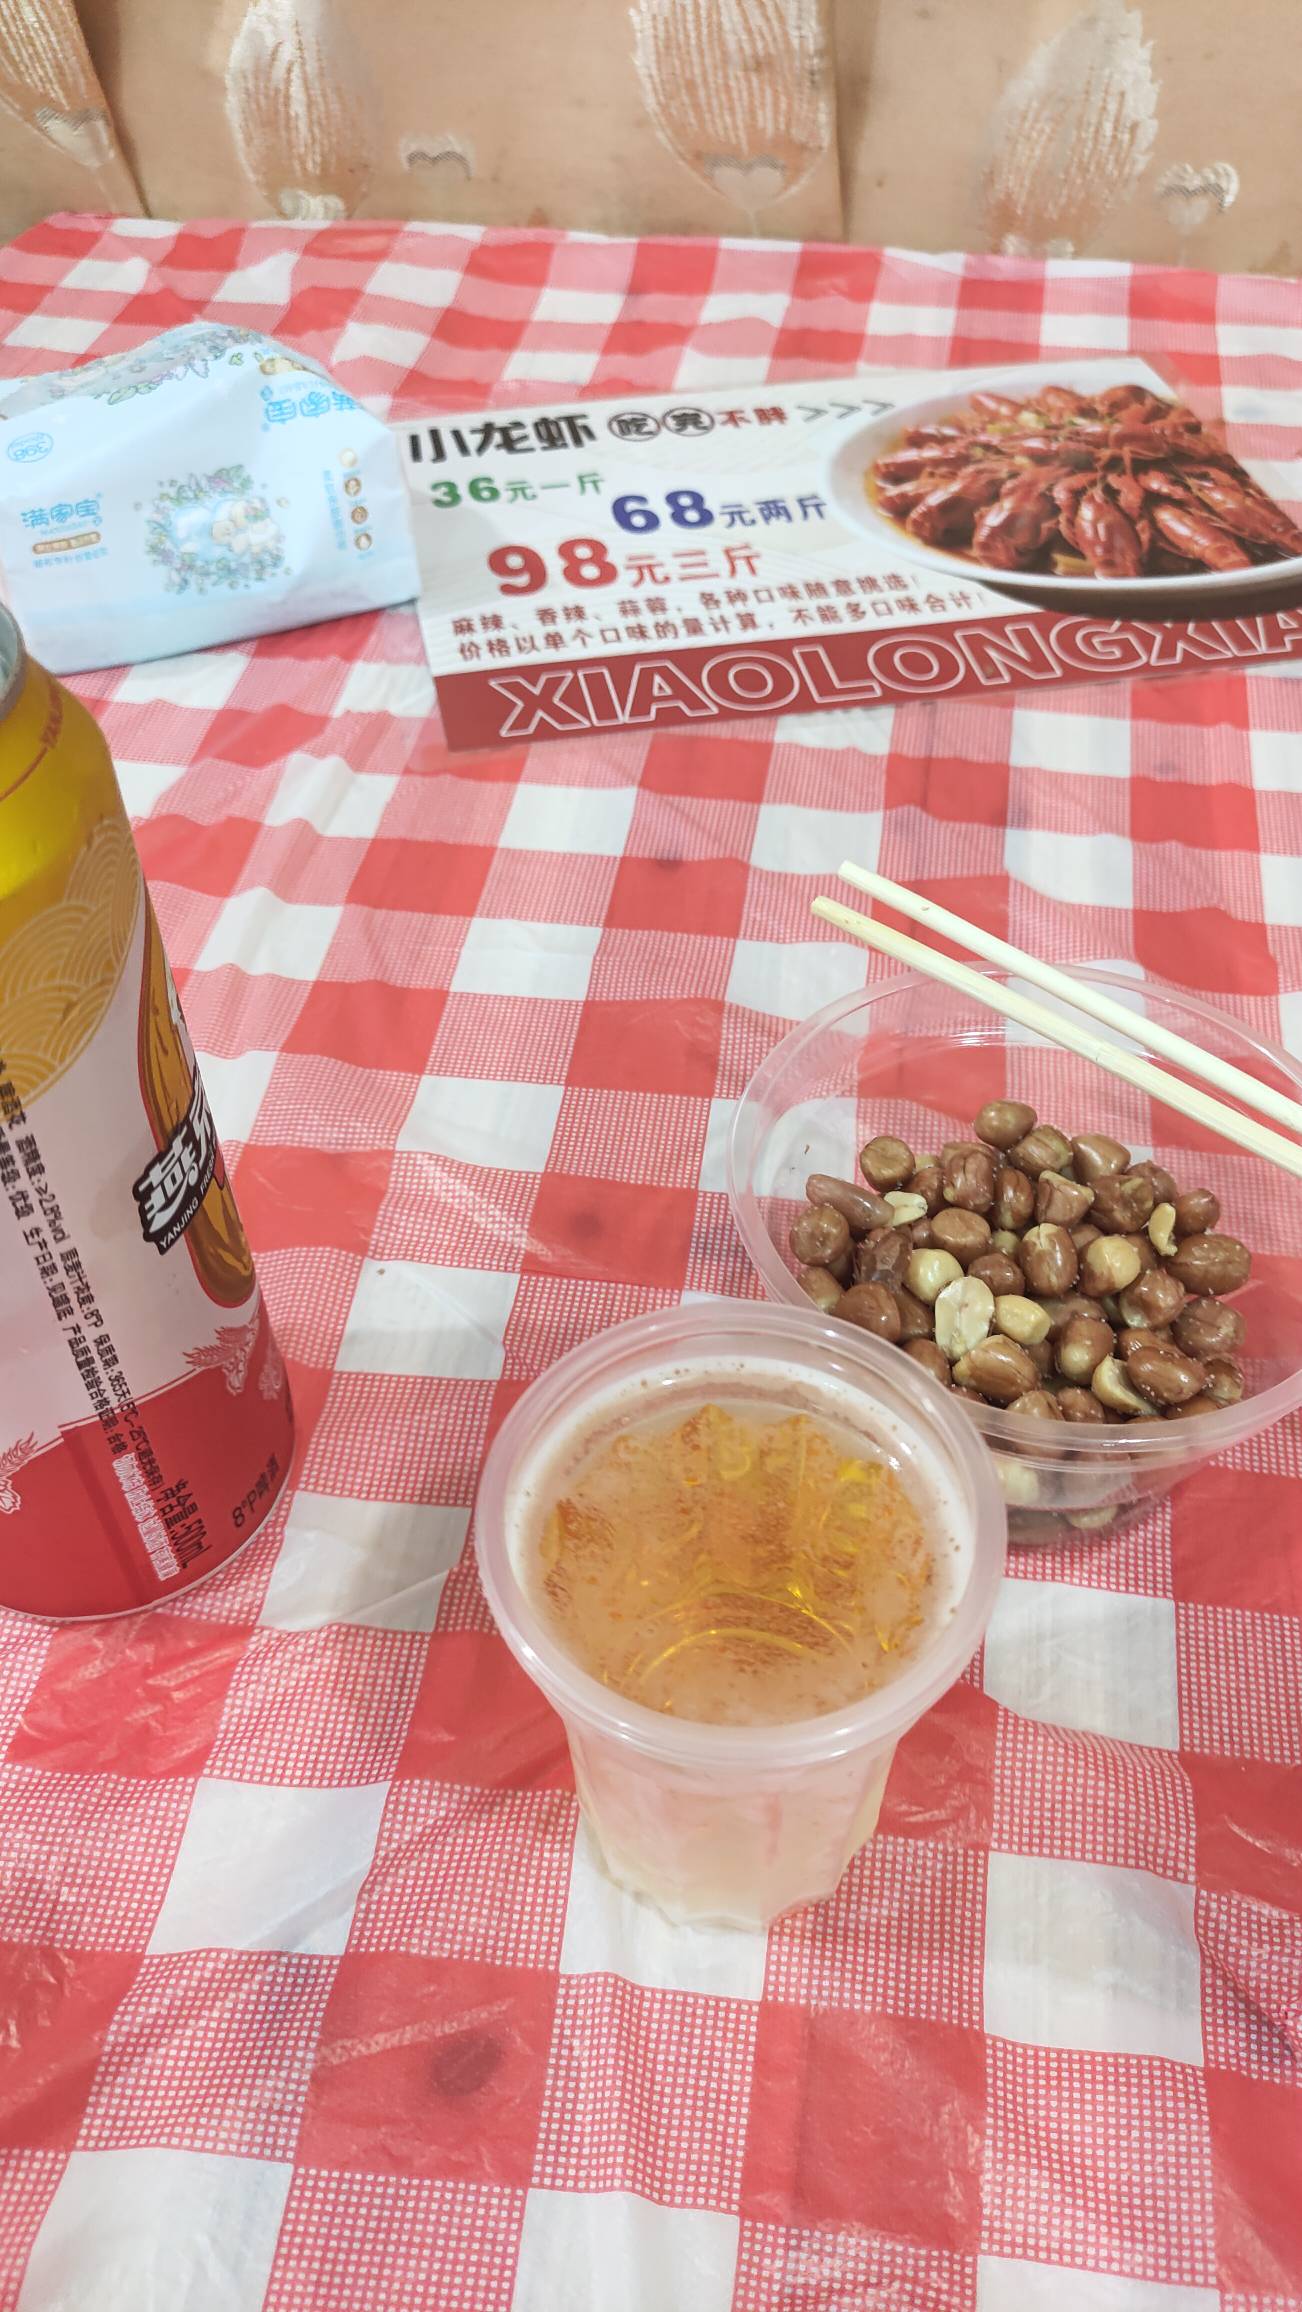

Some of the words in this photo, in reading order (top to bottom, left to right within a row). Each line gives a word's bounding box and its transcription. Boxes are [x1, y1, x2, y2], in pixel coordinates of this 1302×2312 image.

[408, 414, 598, 464] 小龙虾
[20, 499, 99, 530] 满家宝
[429, 471, 606, 510] 36元一斤
[611, 489, 829, 535] 68元两斤
[487, 537, 763, 598] 98元三斤
[160, 1198, 199, 1249] YANJING
